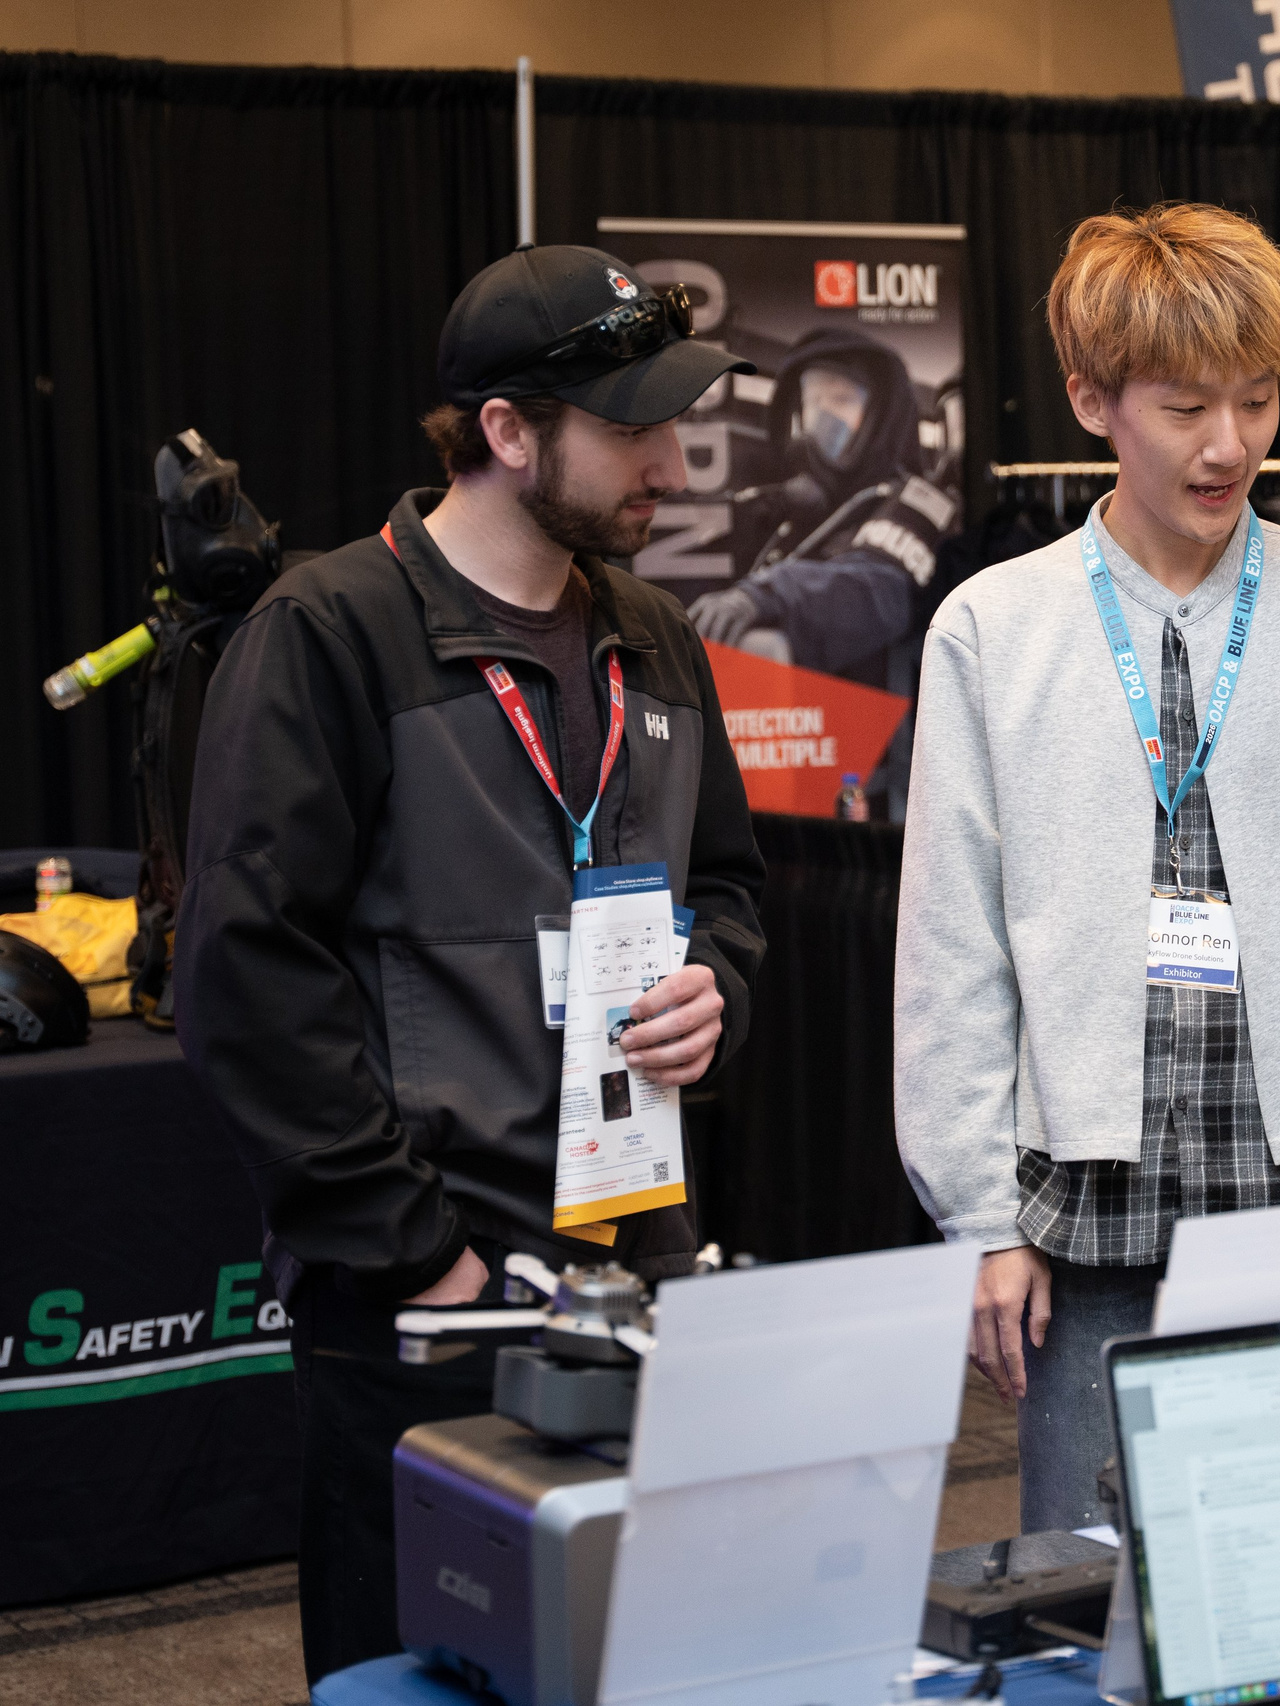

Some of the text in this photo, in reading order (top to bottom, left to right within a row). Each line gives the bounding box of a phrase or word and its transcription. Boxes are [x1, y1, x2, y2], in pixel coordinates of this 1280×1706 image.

[857, 263, 938, 307] LION
[1087, 557, 1101, 572] &
[1091, 571, 1117, 614] BLUE
[1105, 613, 1130, 652] LINE
[1205, 536, 1263, 746] 2026 OACP & BLUE LINE EXPO
[1117, 651, 1145, 700] EXPO
[609, 721, 620, 756] Apparel
[645, 712, 670, 740] HH
[514, 706, 553, 780] Uniform Insignia
[1174, 911, 1210, 921] BLUE LINE
[1174, 917, 1194, 925] EXPO
[1148, 933, 1231, 950] onnor Ren
[1163, 967, 1203, 979] Exhibitor
[1172, 952, 1193, 960] Drone
[1193, 954, 1224, 963] Solutions
[623, 1133, 645, 1142] ONTARIO
[23, 1288, 206, 1366] SAFETY
[211, 1260, 294, 1340] EQ
